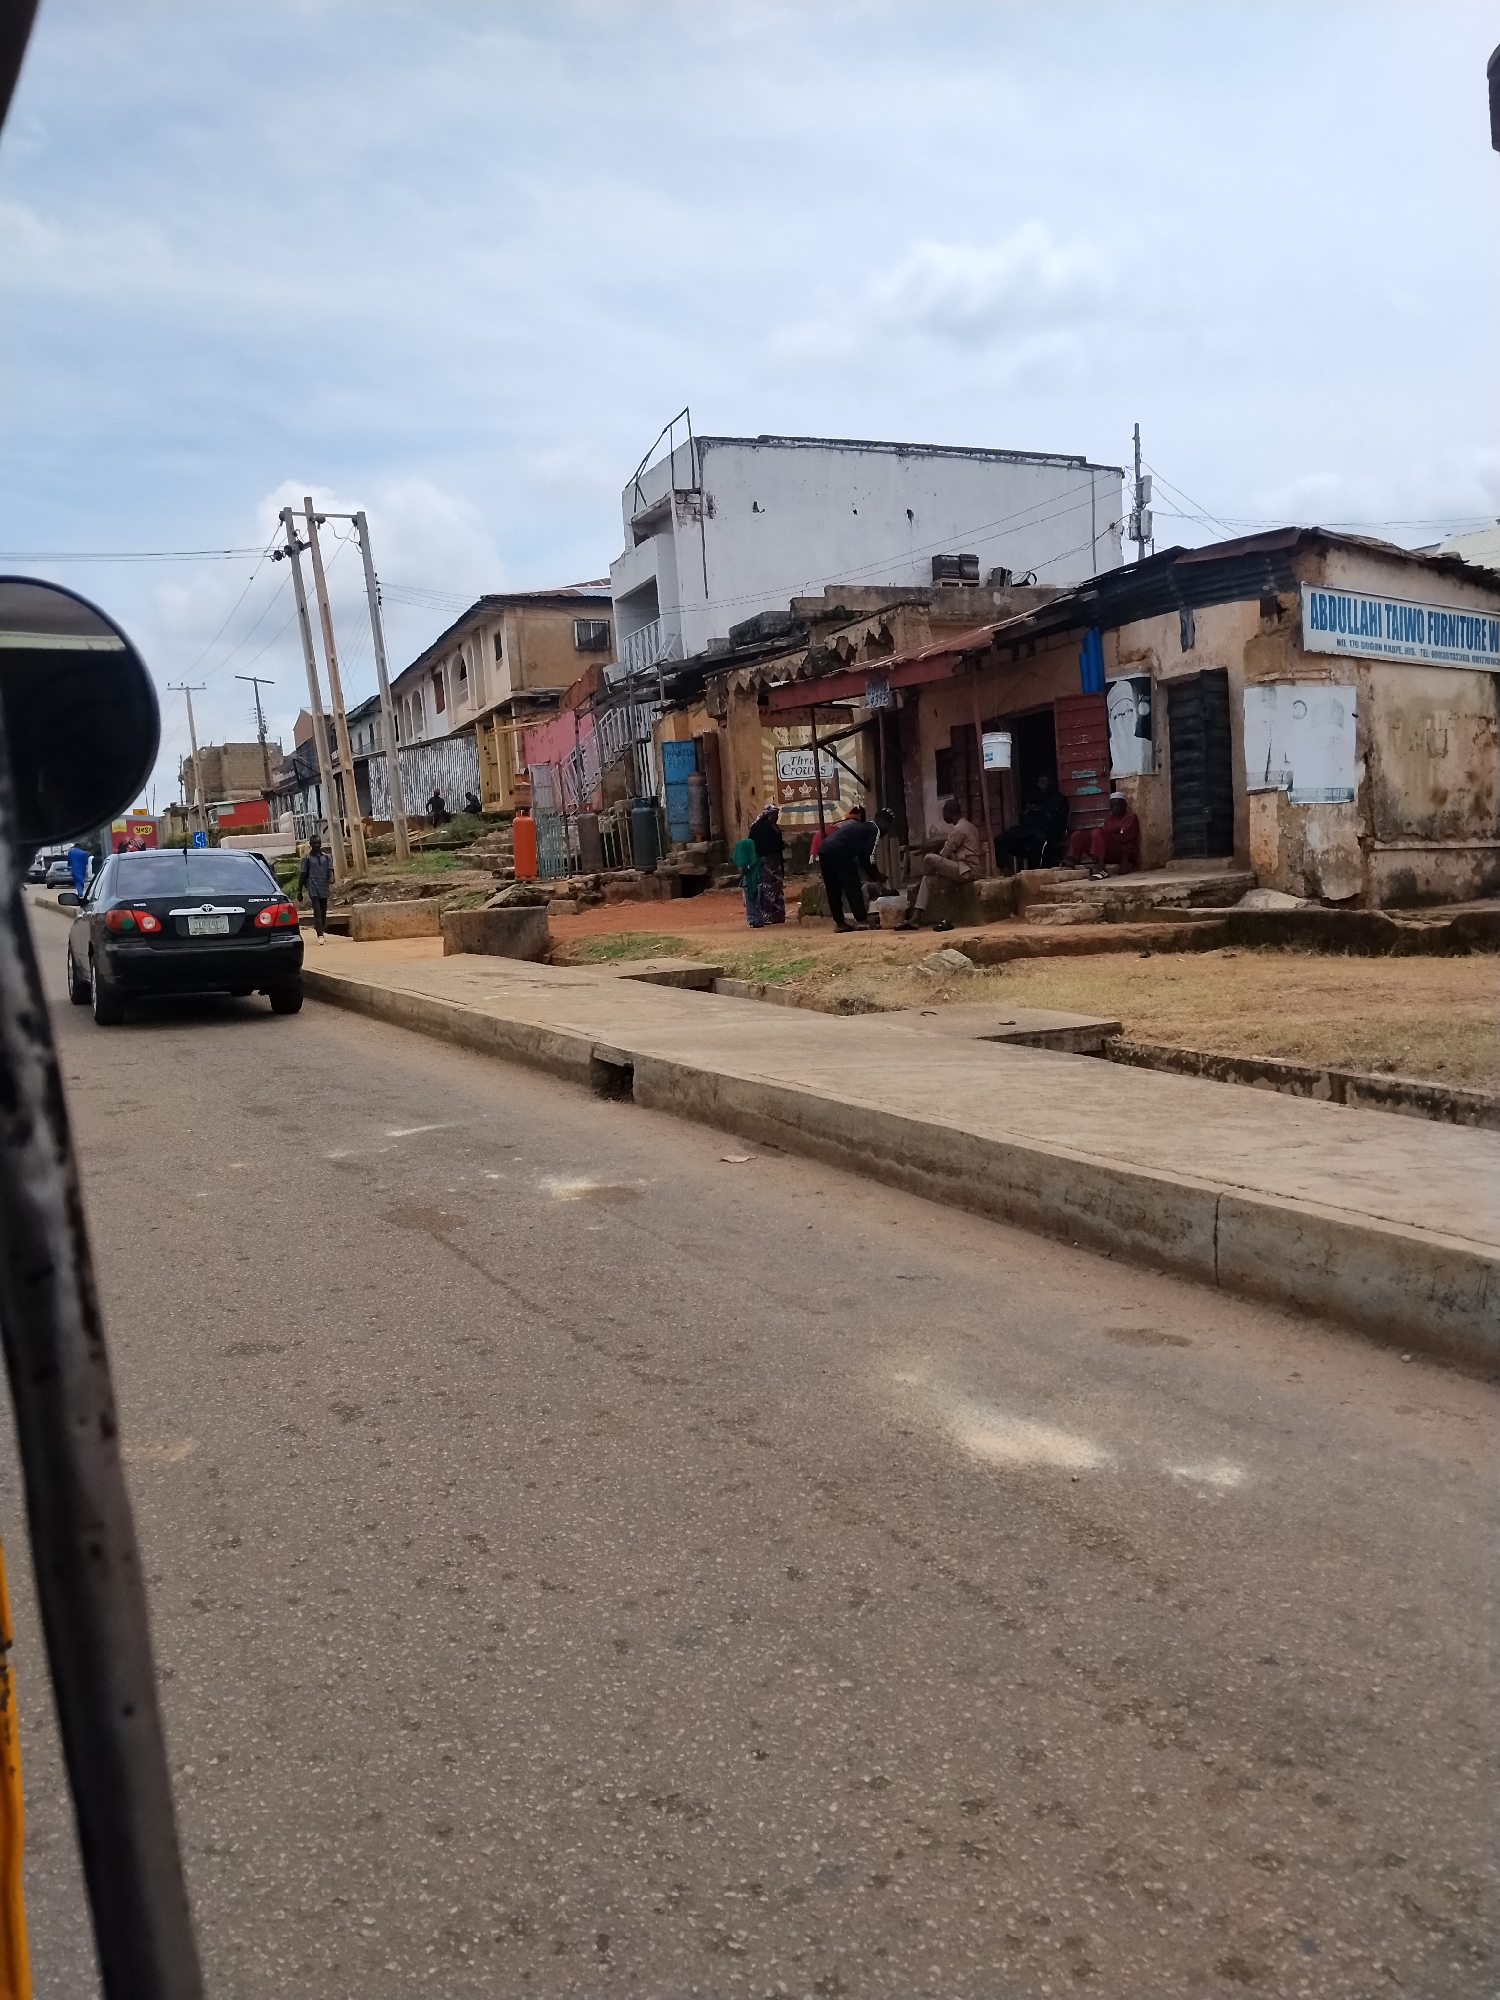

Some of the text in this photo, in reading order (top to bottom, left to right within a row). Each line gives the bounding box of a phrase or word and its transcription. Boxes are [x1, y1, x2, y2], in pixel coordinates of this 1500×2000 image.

[1310, 592, 1382, 638] ABDULLAHI
[1384, 603, 1425, 645] TAIWO
[1427, 610, 1487, 652] FURNITURE
[790, 756, 815, 766] Thre
[781, 763, 826, 775] Crows
